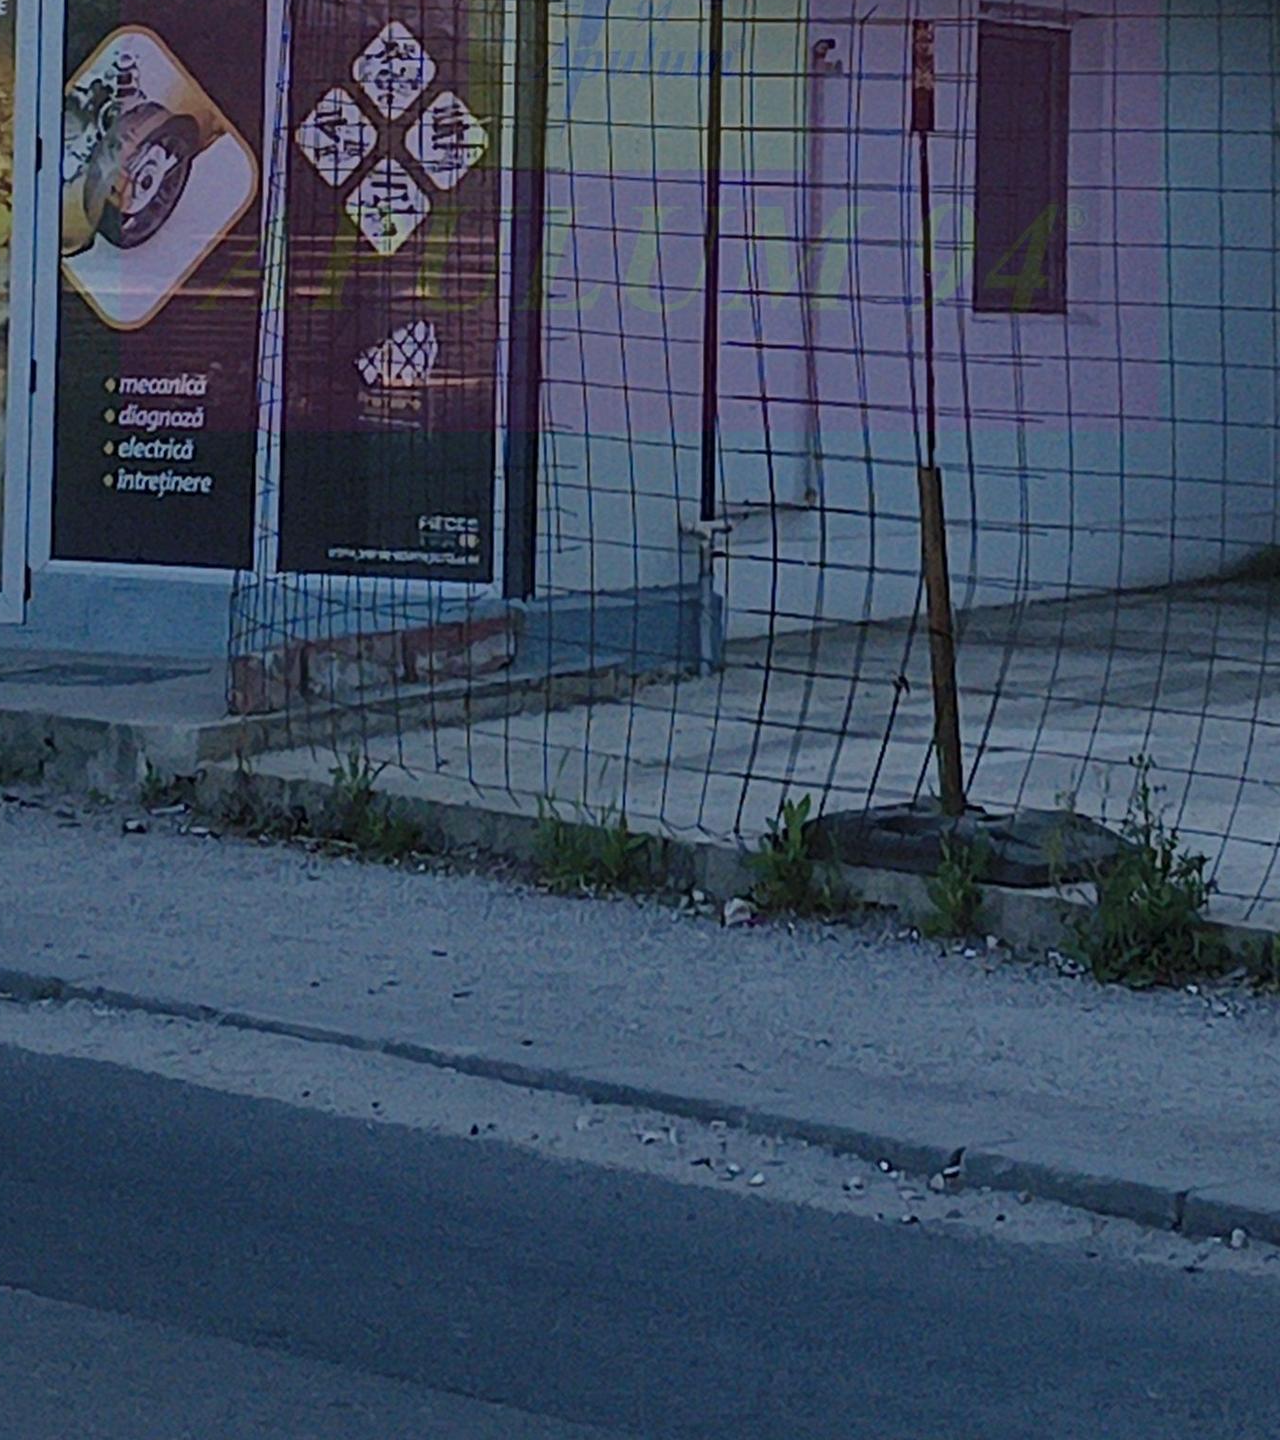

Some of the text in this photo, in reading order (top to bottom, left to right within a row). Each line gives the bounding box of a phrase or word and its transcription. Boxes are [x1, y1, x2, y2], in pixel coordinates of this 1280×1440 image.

[119, 373, 207, 395] mecanică
[118, 404, 204, 432] diagnoză
[118, 436, 194, 459] electrică
